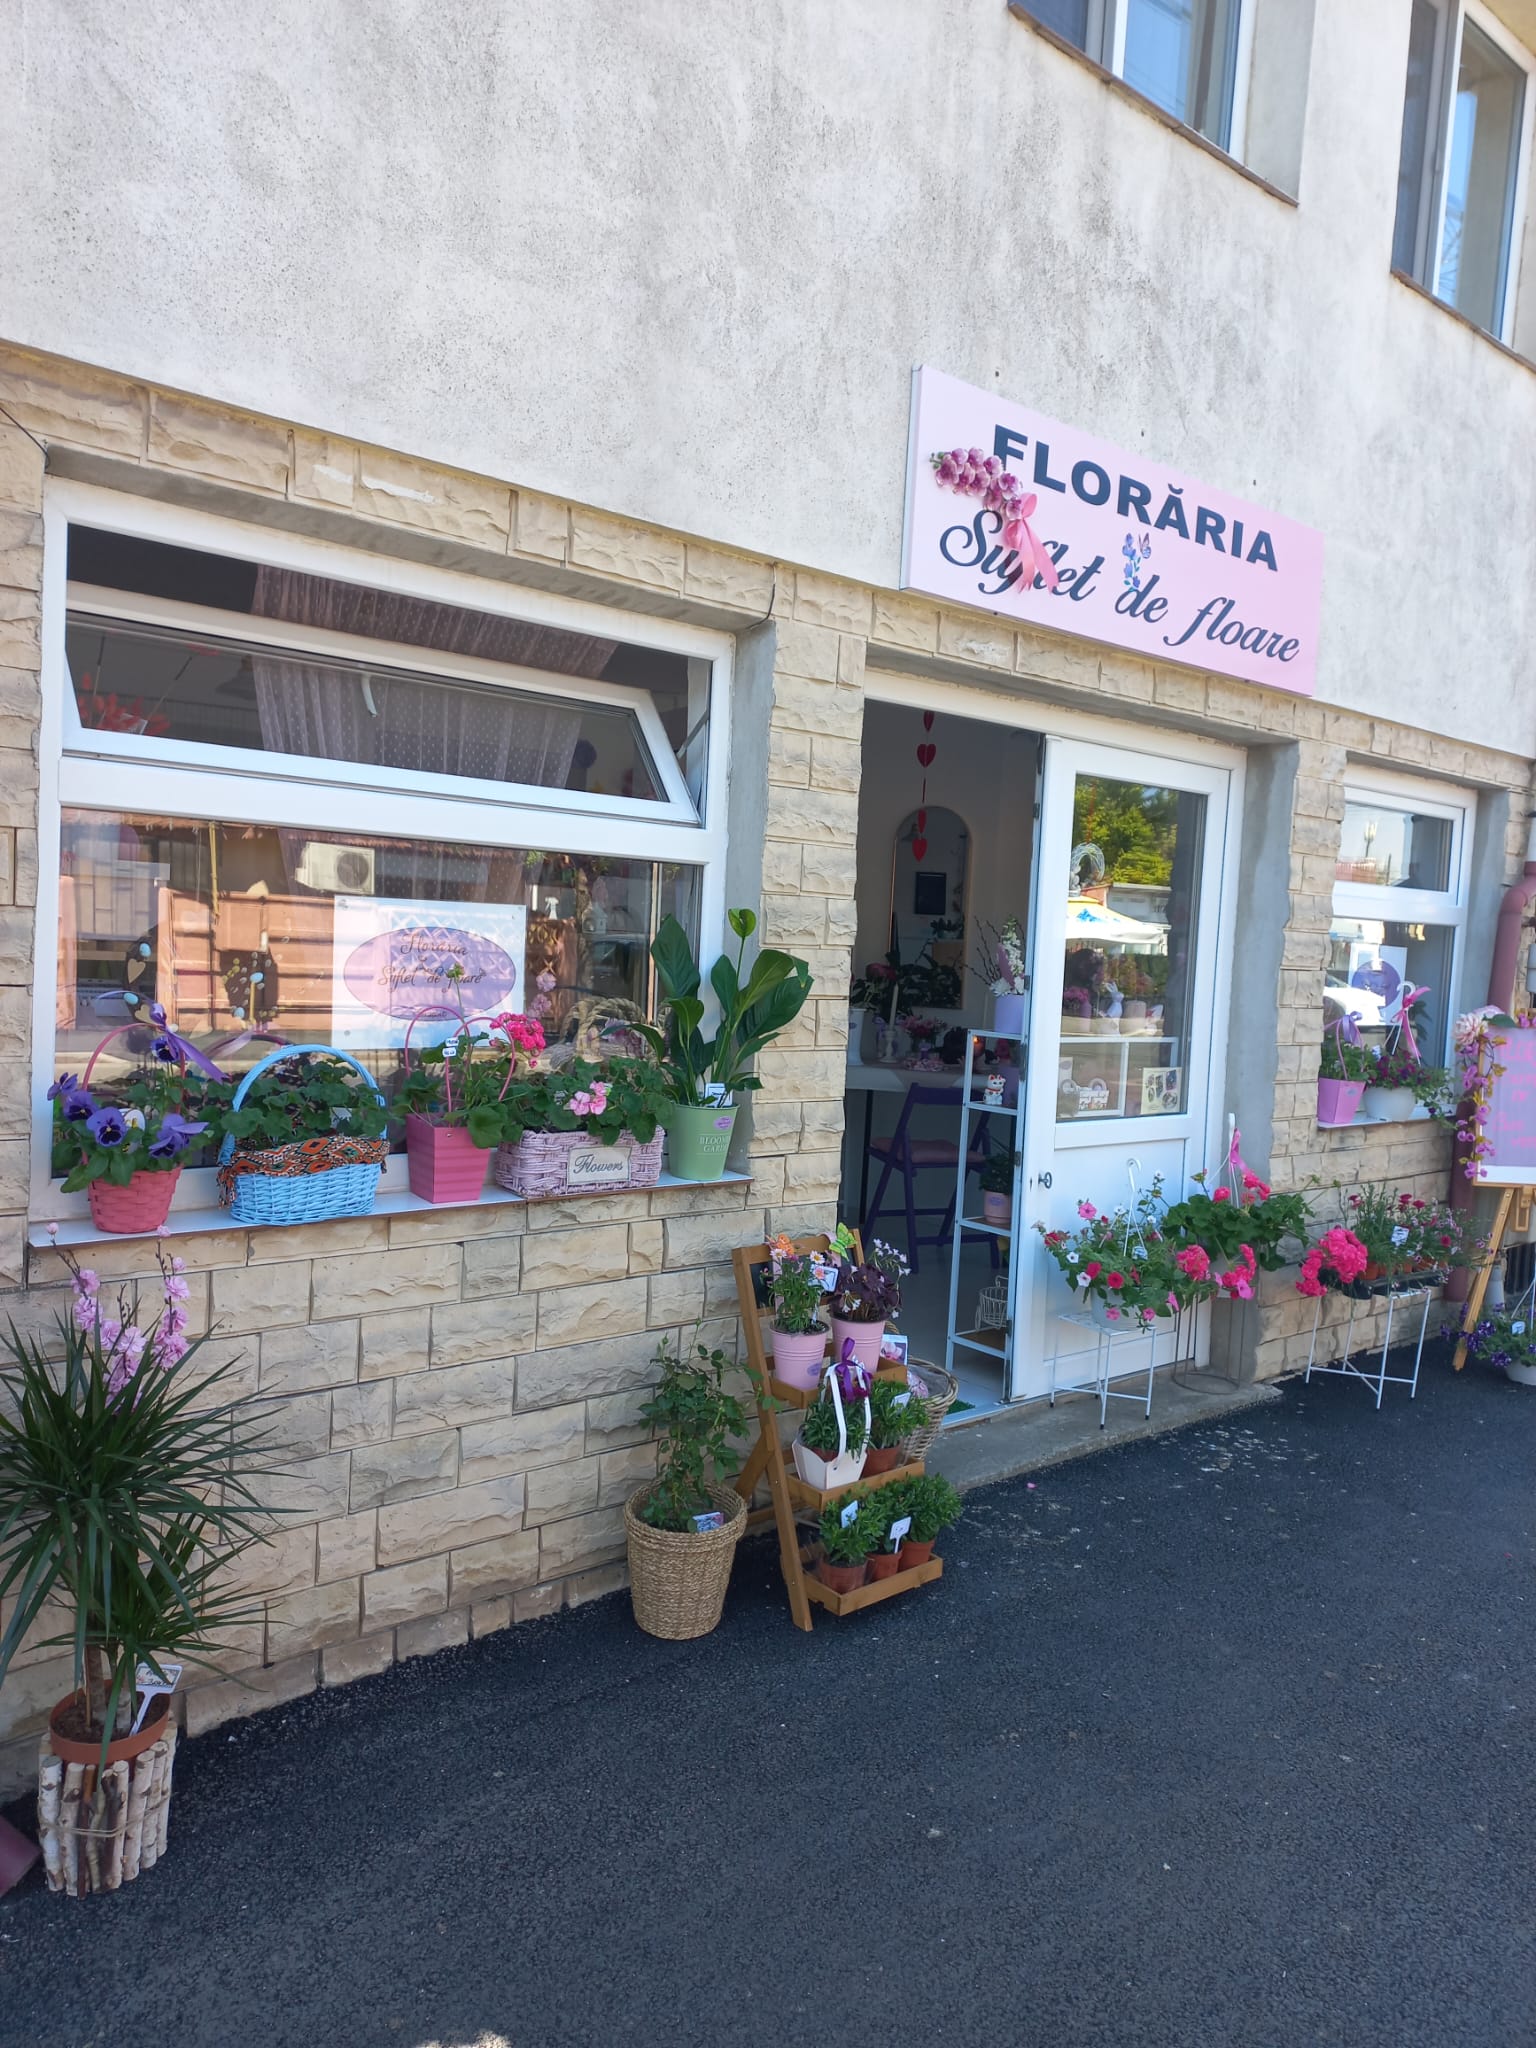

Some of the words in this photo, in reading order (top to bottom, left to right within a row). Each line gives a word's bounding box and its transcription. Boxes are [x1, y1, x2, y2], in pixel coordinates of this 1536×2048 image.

[993, 424, 1279, 571] FLORĂRIA
[1115, 575, 1168, 623] de
[1163, 597, 1300, 662] floare
[573, 1154, 623, 1174] Flowers
